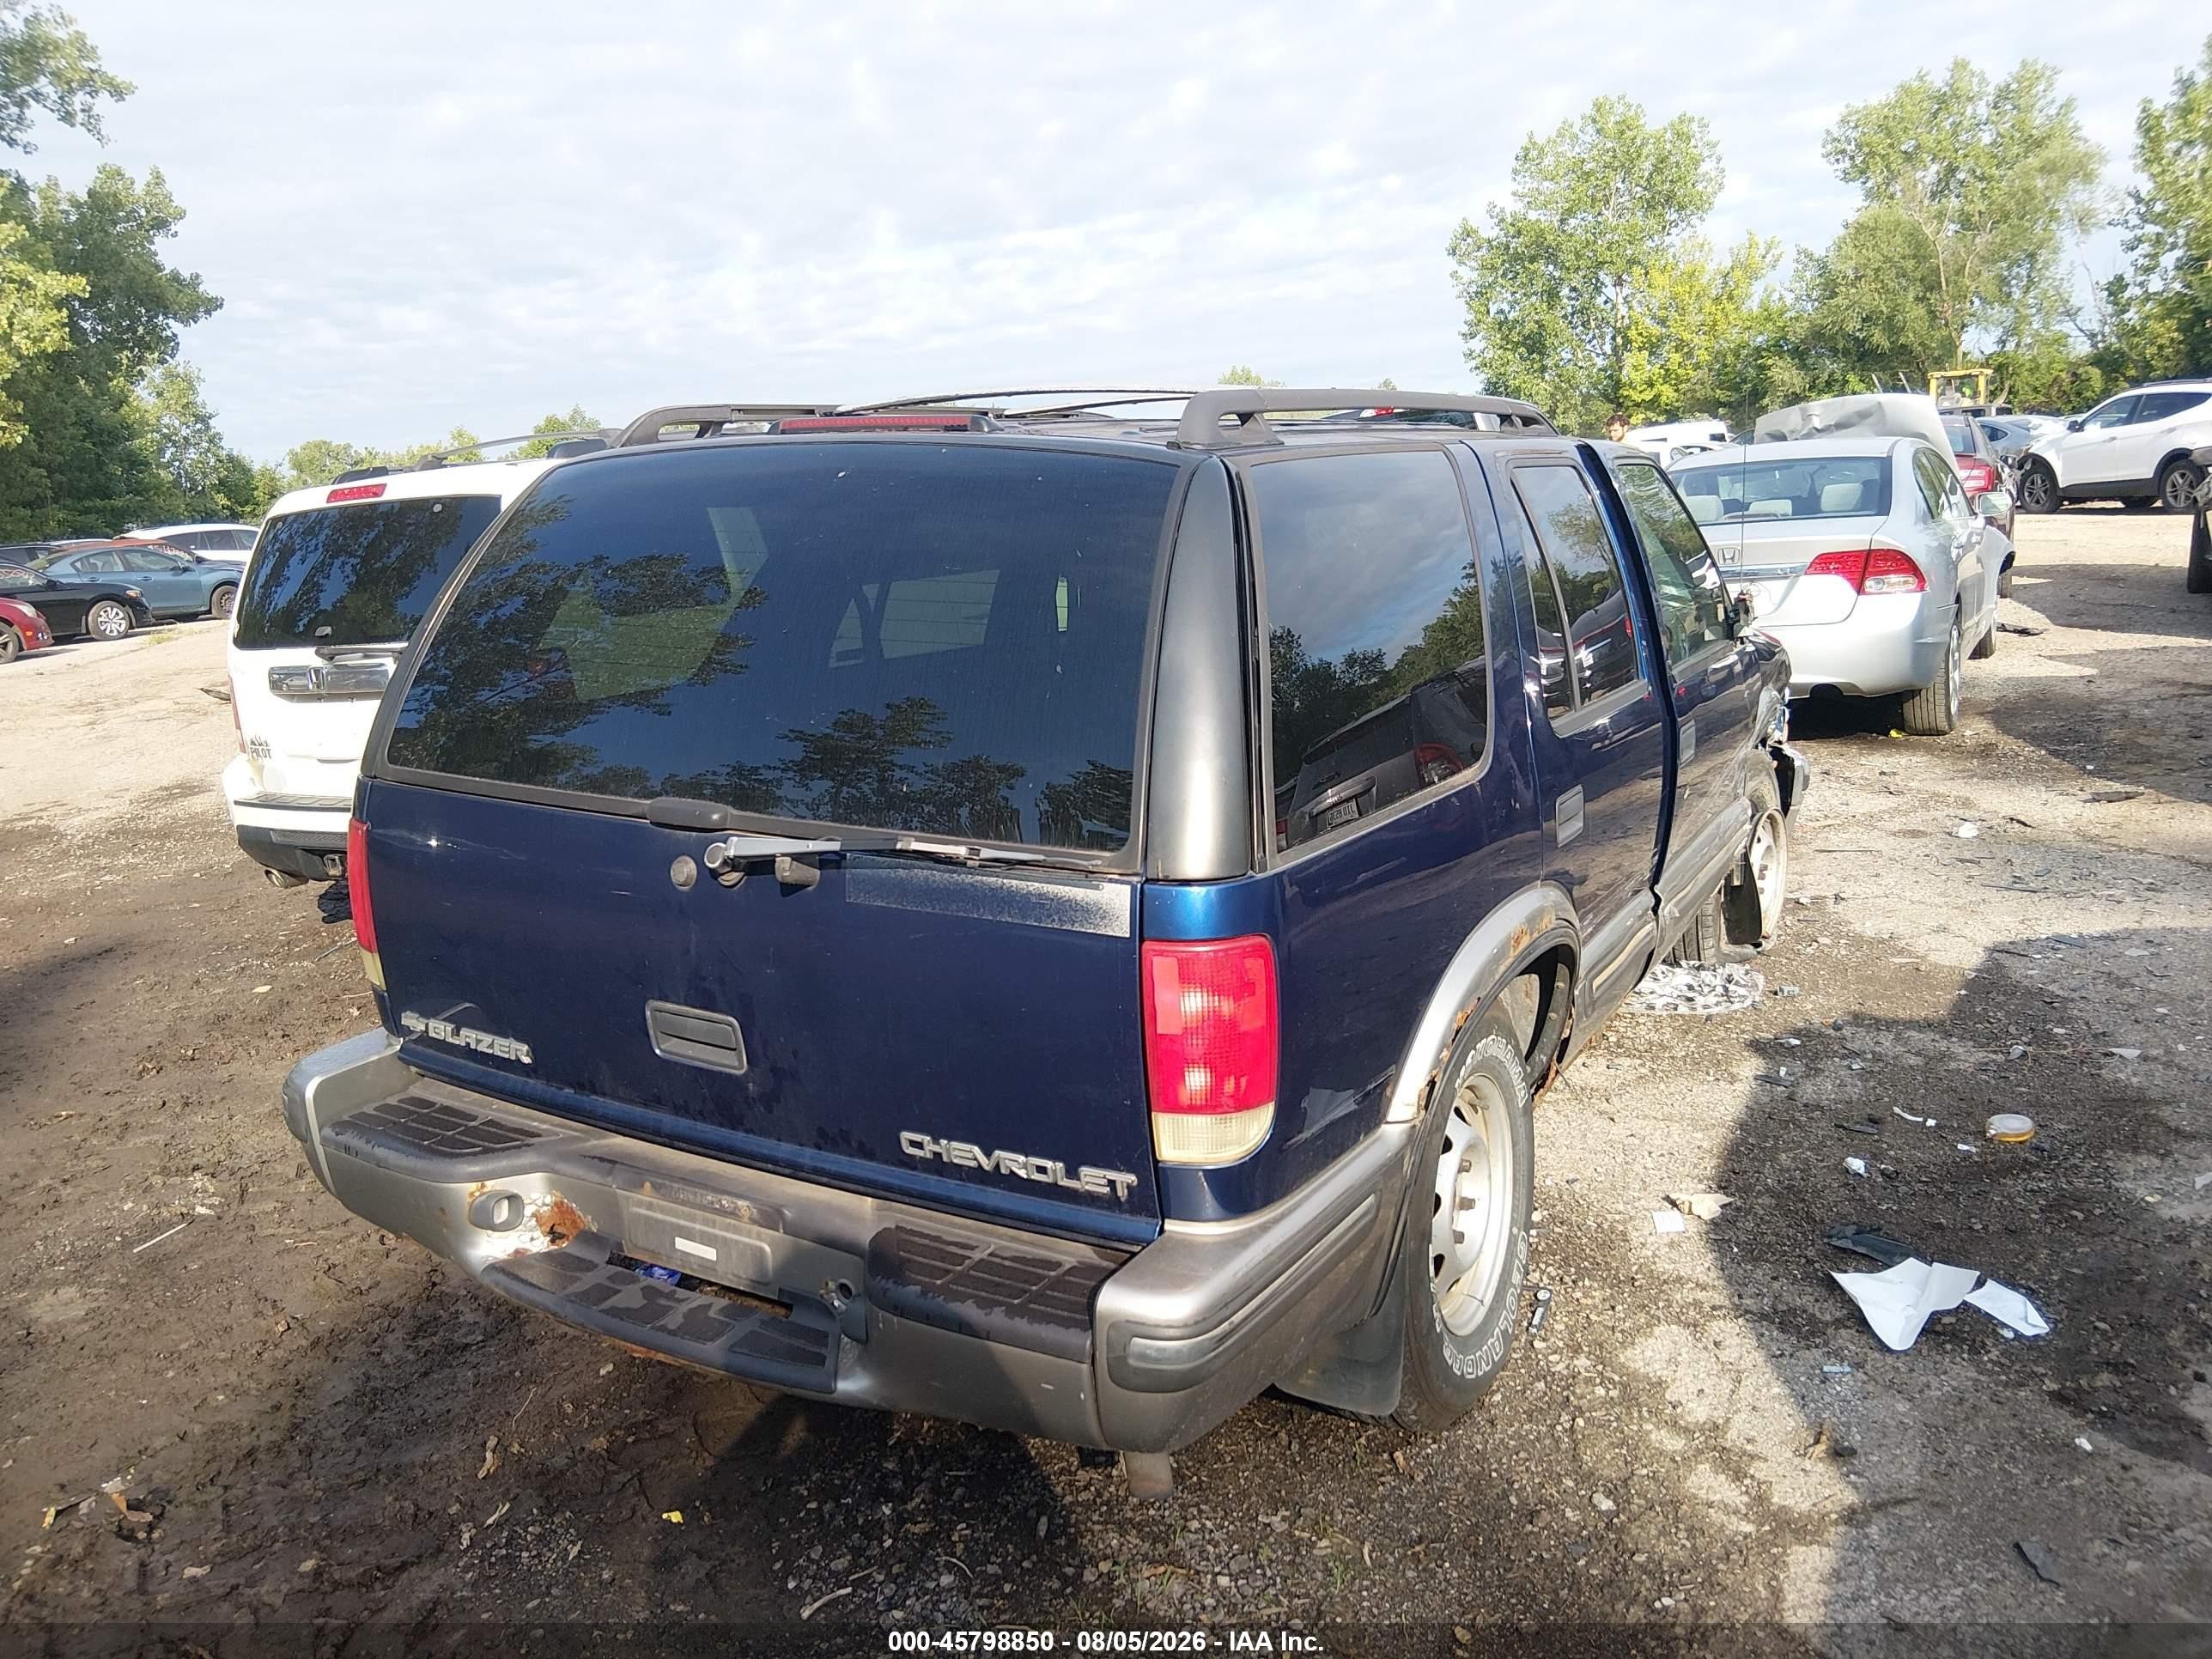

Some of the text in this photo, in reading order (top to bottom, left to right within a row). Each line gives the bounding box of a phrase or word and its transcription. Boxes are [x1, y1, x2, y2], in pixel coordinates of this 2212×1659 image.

[250, 747, 271, 759] PILOT
[428, 1018, 534, 1065] BLAZER
[900, 1131, 1138, 1201] CHEVROLET
